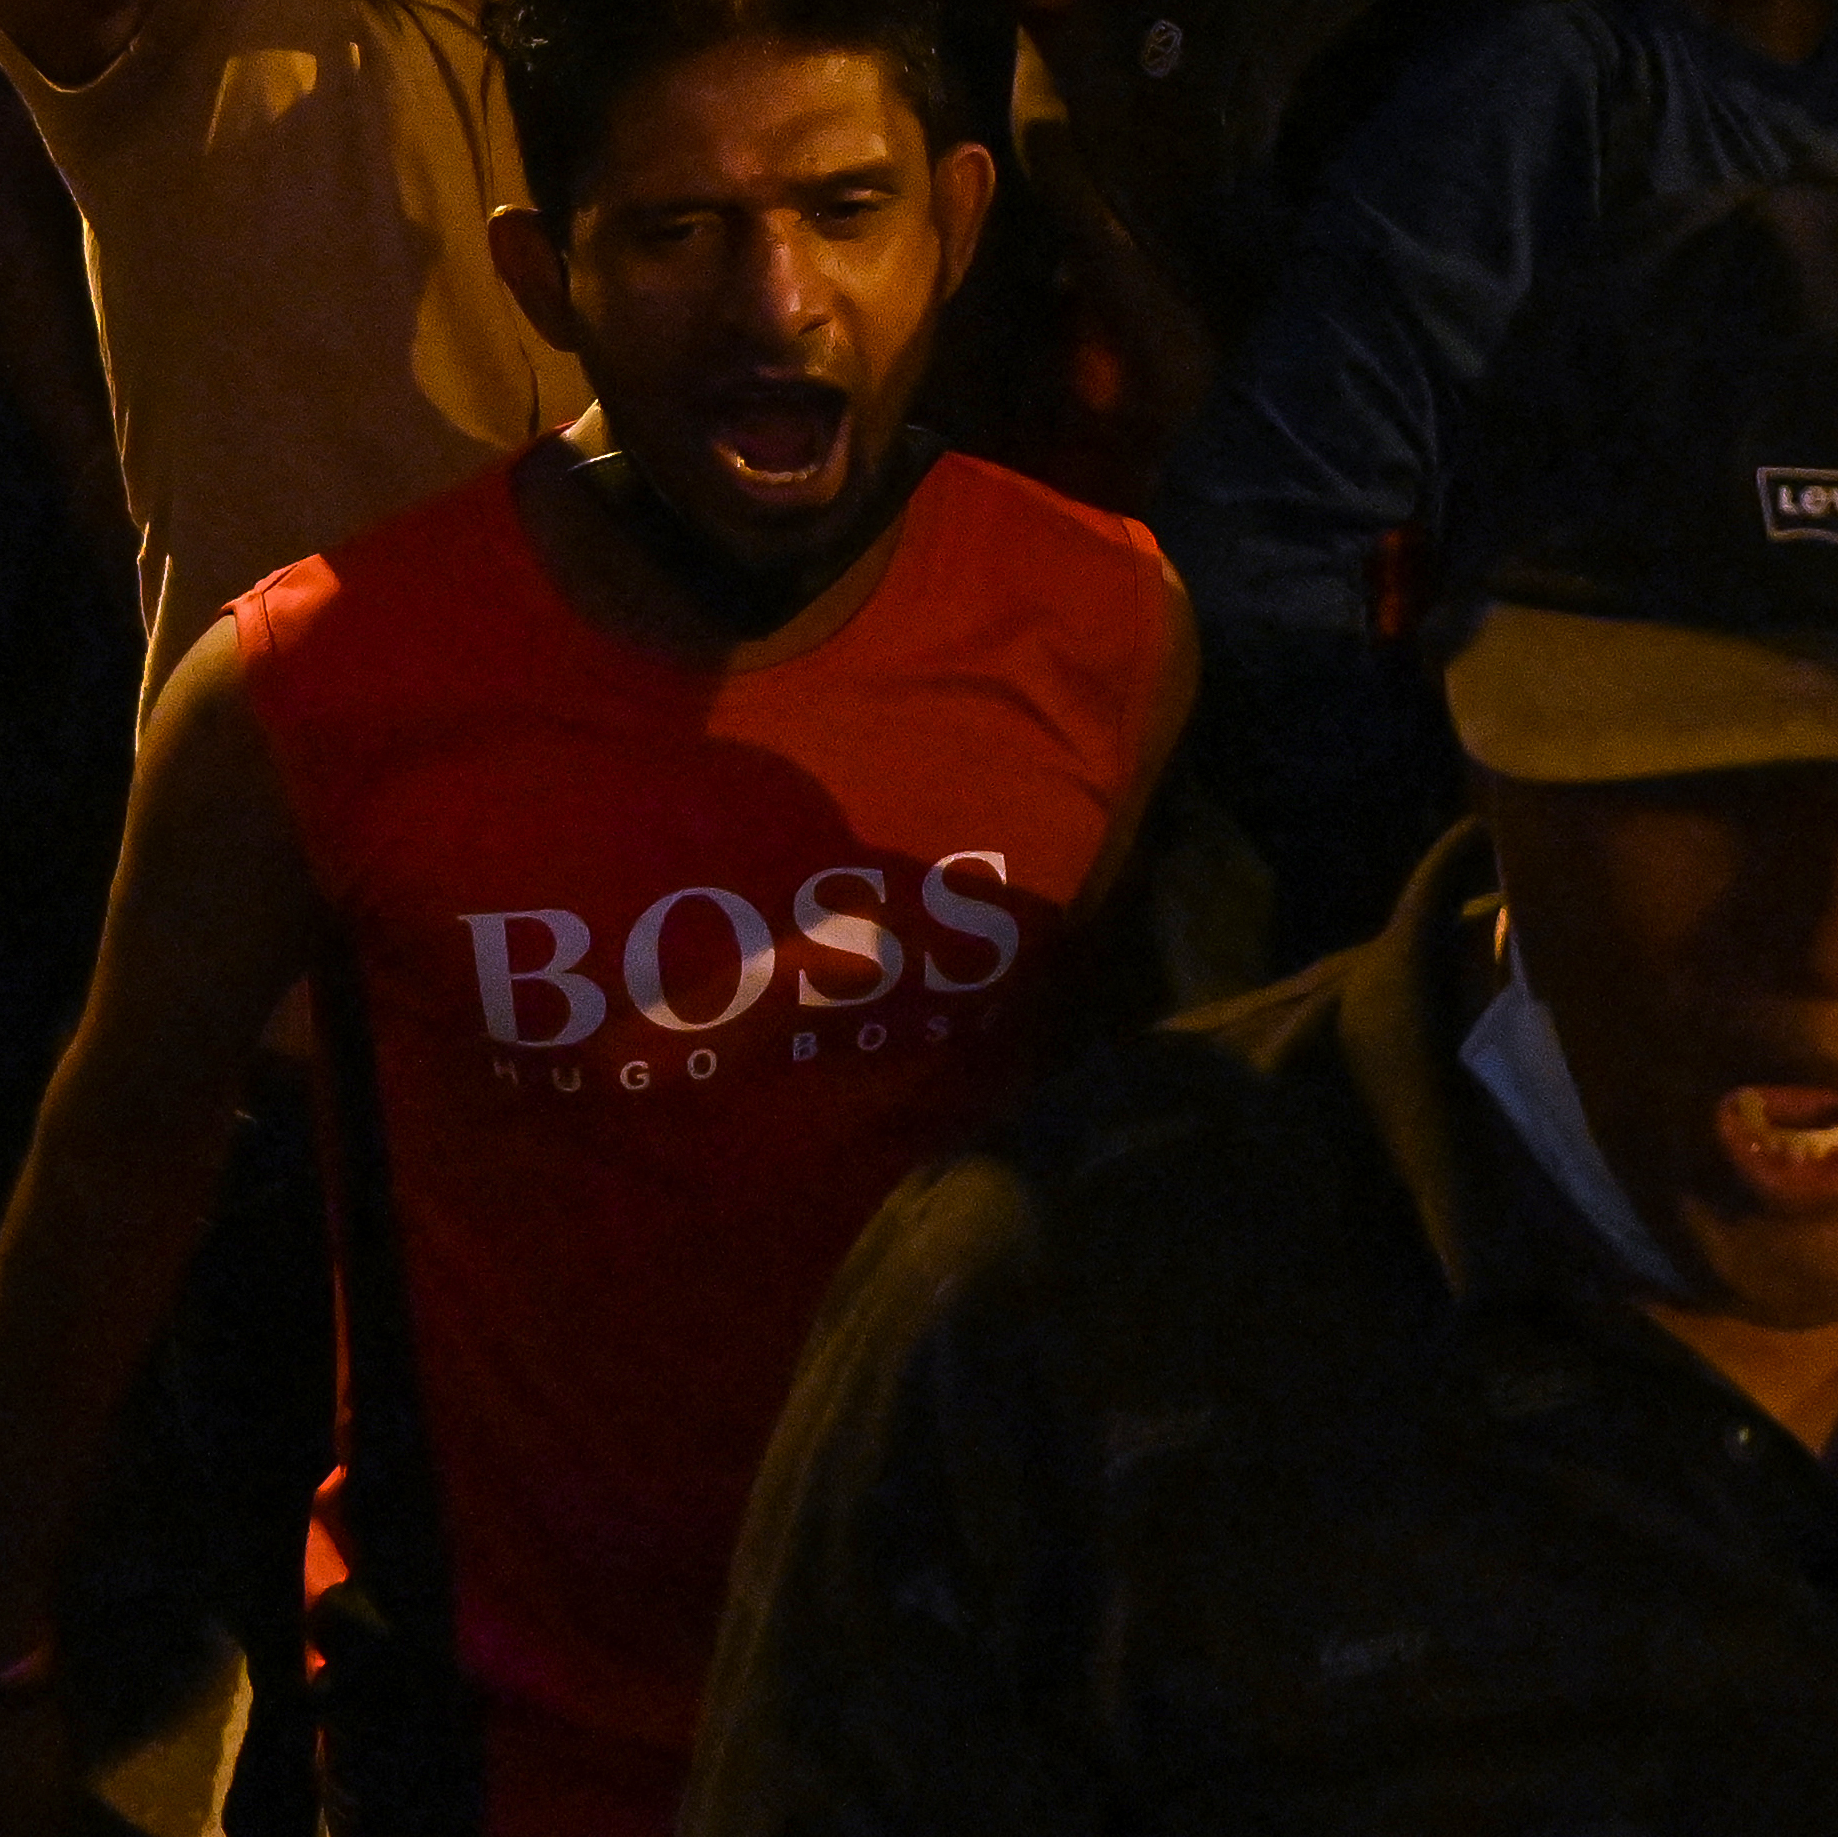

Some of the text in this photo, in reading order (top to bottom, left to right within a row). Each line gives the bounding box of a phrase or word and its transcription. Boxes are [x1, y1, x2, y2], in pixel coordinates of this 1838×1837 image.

[456, 849, 1021, 1049] BOSS
[491, 1005, 1005, 1094] HUGO BOS
